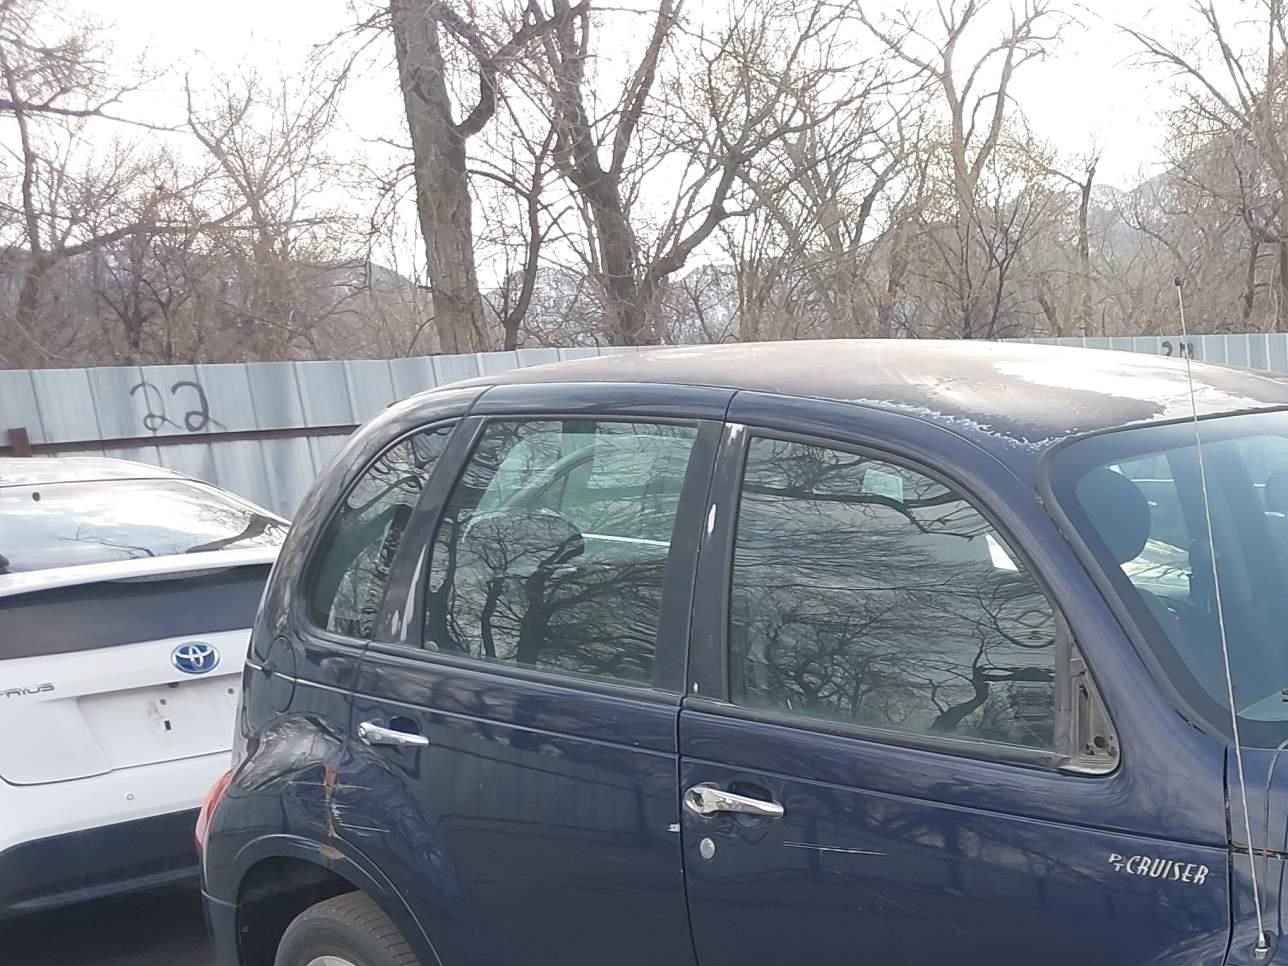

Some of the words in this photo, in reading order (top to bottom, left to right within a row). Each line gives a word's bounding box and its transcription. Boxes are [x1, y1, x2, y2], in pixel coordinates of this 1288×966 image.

[129, 381, 228, 432] 22
[0, 680, 55, 698] RIUS
[1126, 855, 1210, 885] CRUISER
